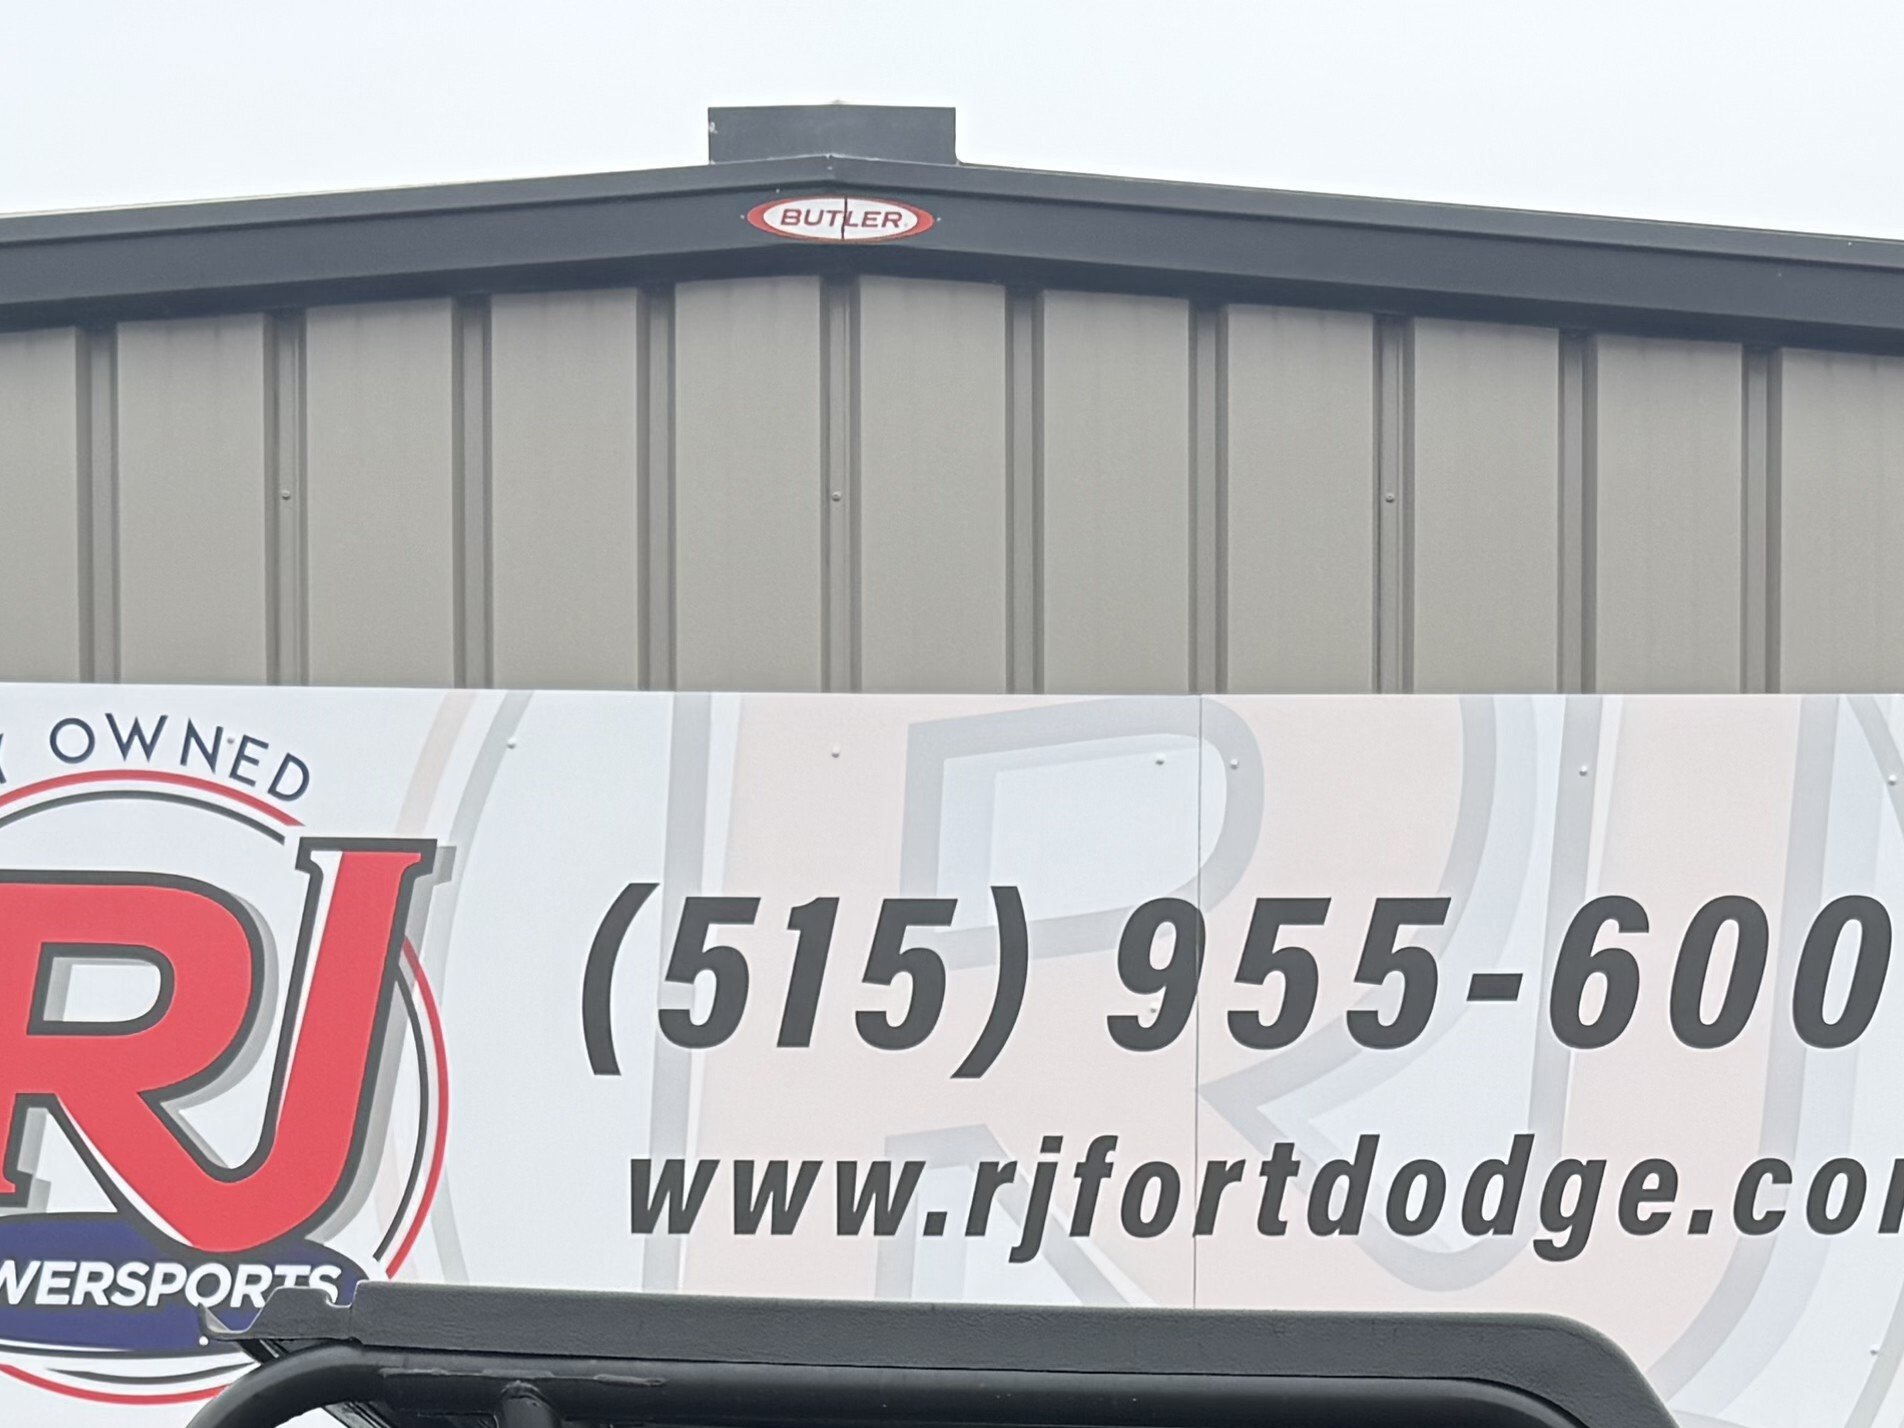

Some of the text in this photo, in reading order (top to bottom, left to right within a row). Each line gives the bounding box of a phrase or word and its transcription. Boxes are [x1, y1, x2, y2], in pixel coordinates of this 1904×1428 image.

[780, 207, 903, 229] BUTLER
[48, 712, 311, 804] OWNED
[582, 882, 1029, 1079] (515)
